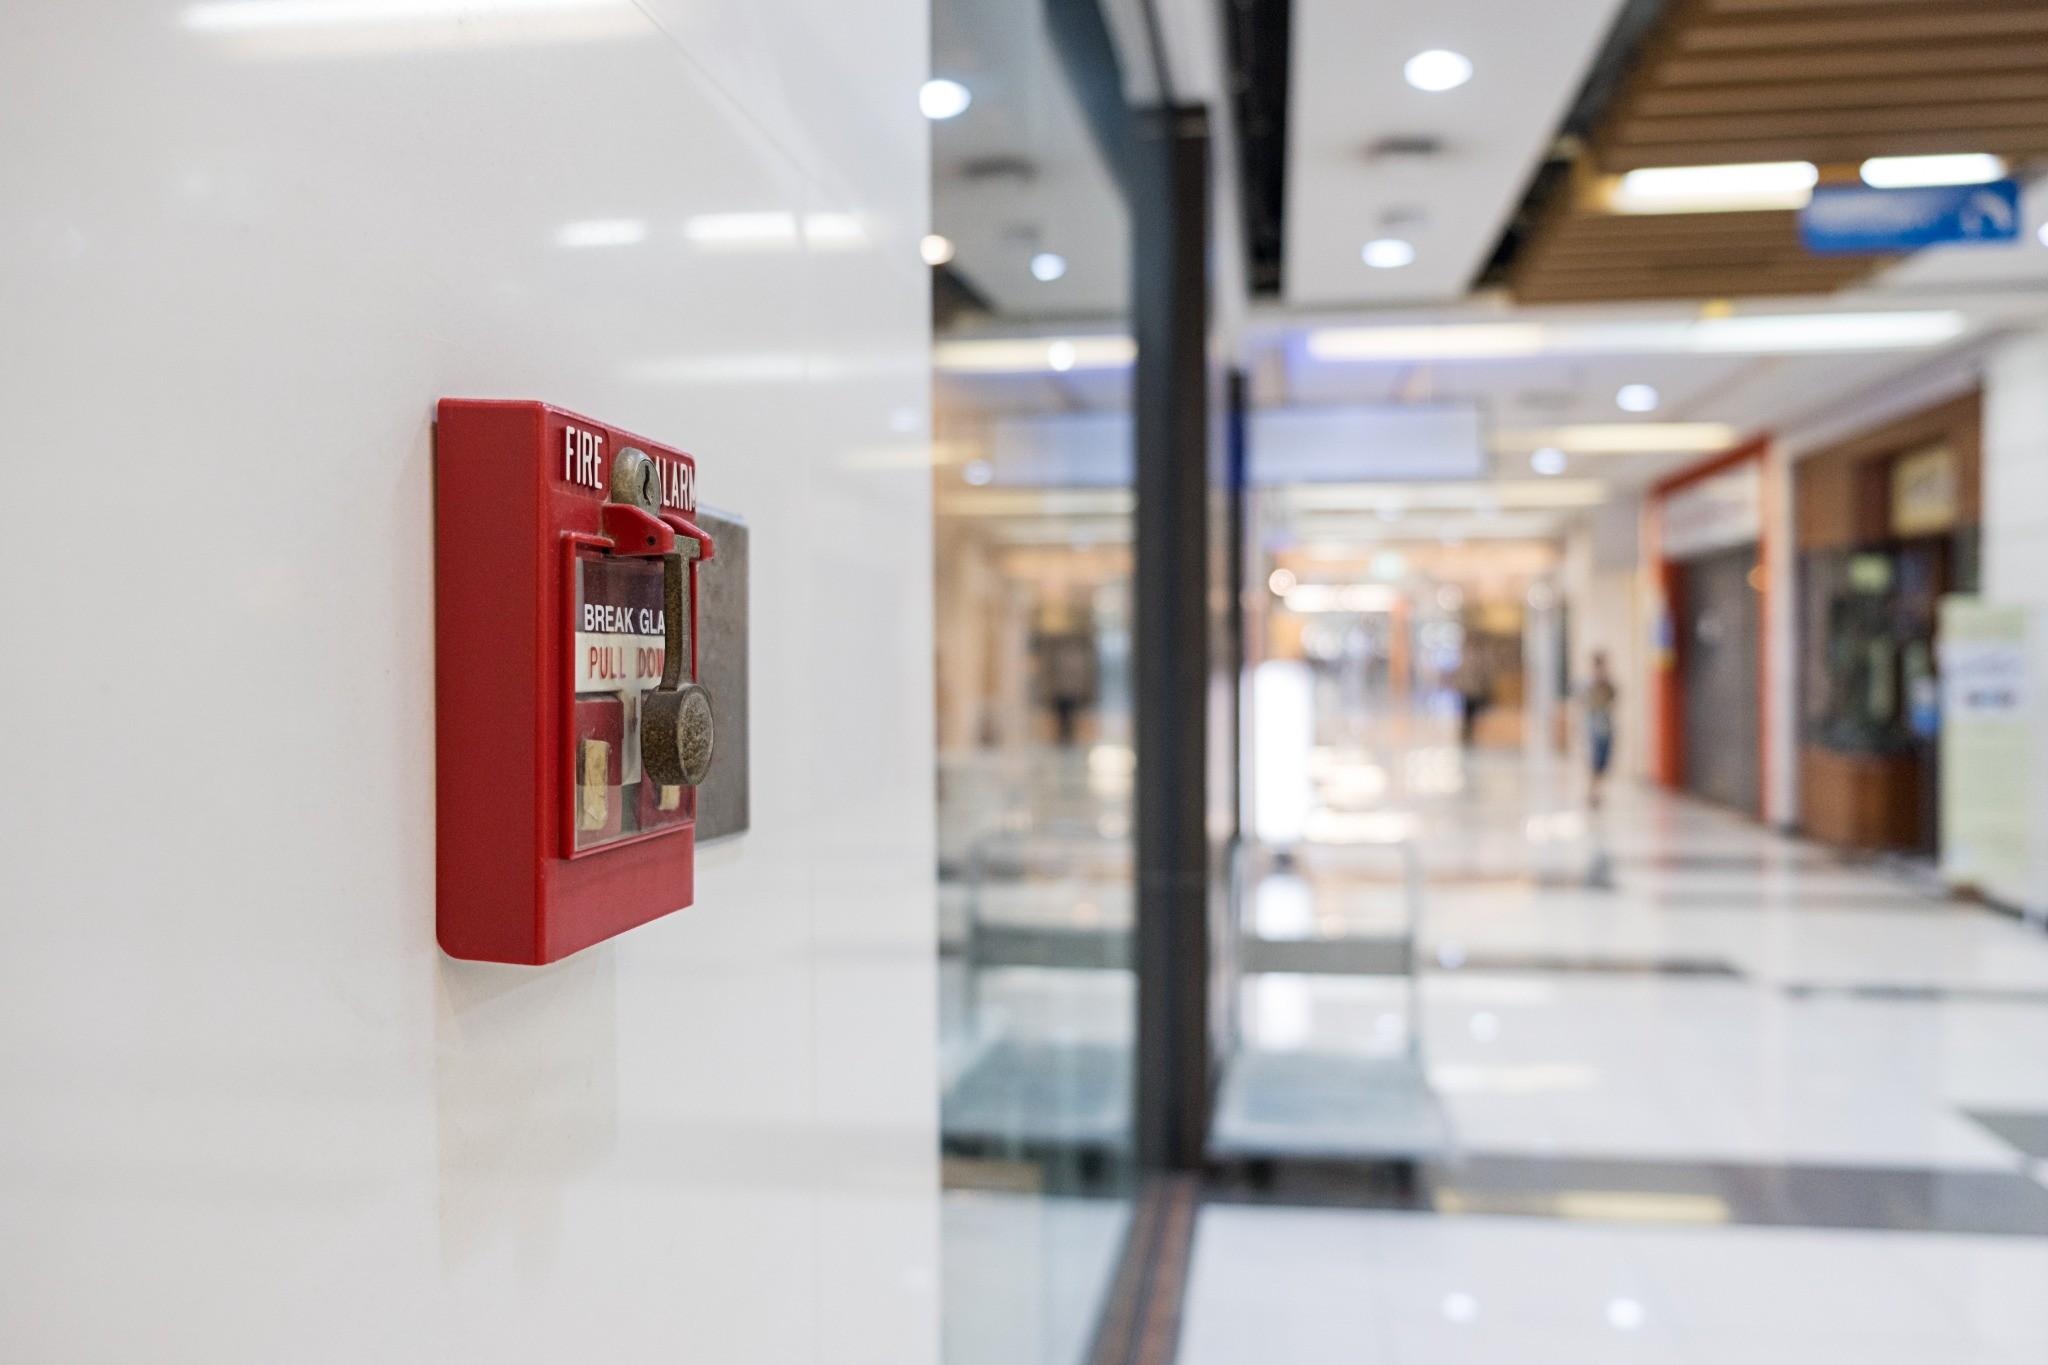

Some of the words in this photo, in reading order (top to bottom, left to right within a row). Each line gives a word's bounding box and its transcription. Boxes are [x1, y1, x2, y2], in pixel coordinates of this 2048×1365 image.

[566, 426, 602, 489] FIRE
[584, 603, 634, 633] BREAK
[639, 608, 665, 634] GLA
[589, 646, 626, 679] PULL
